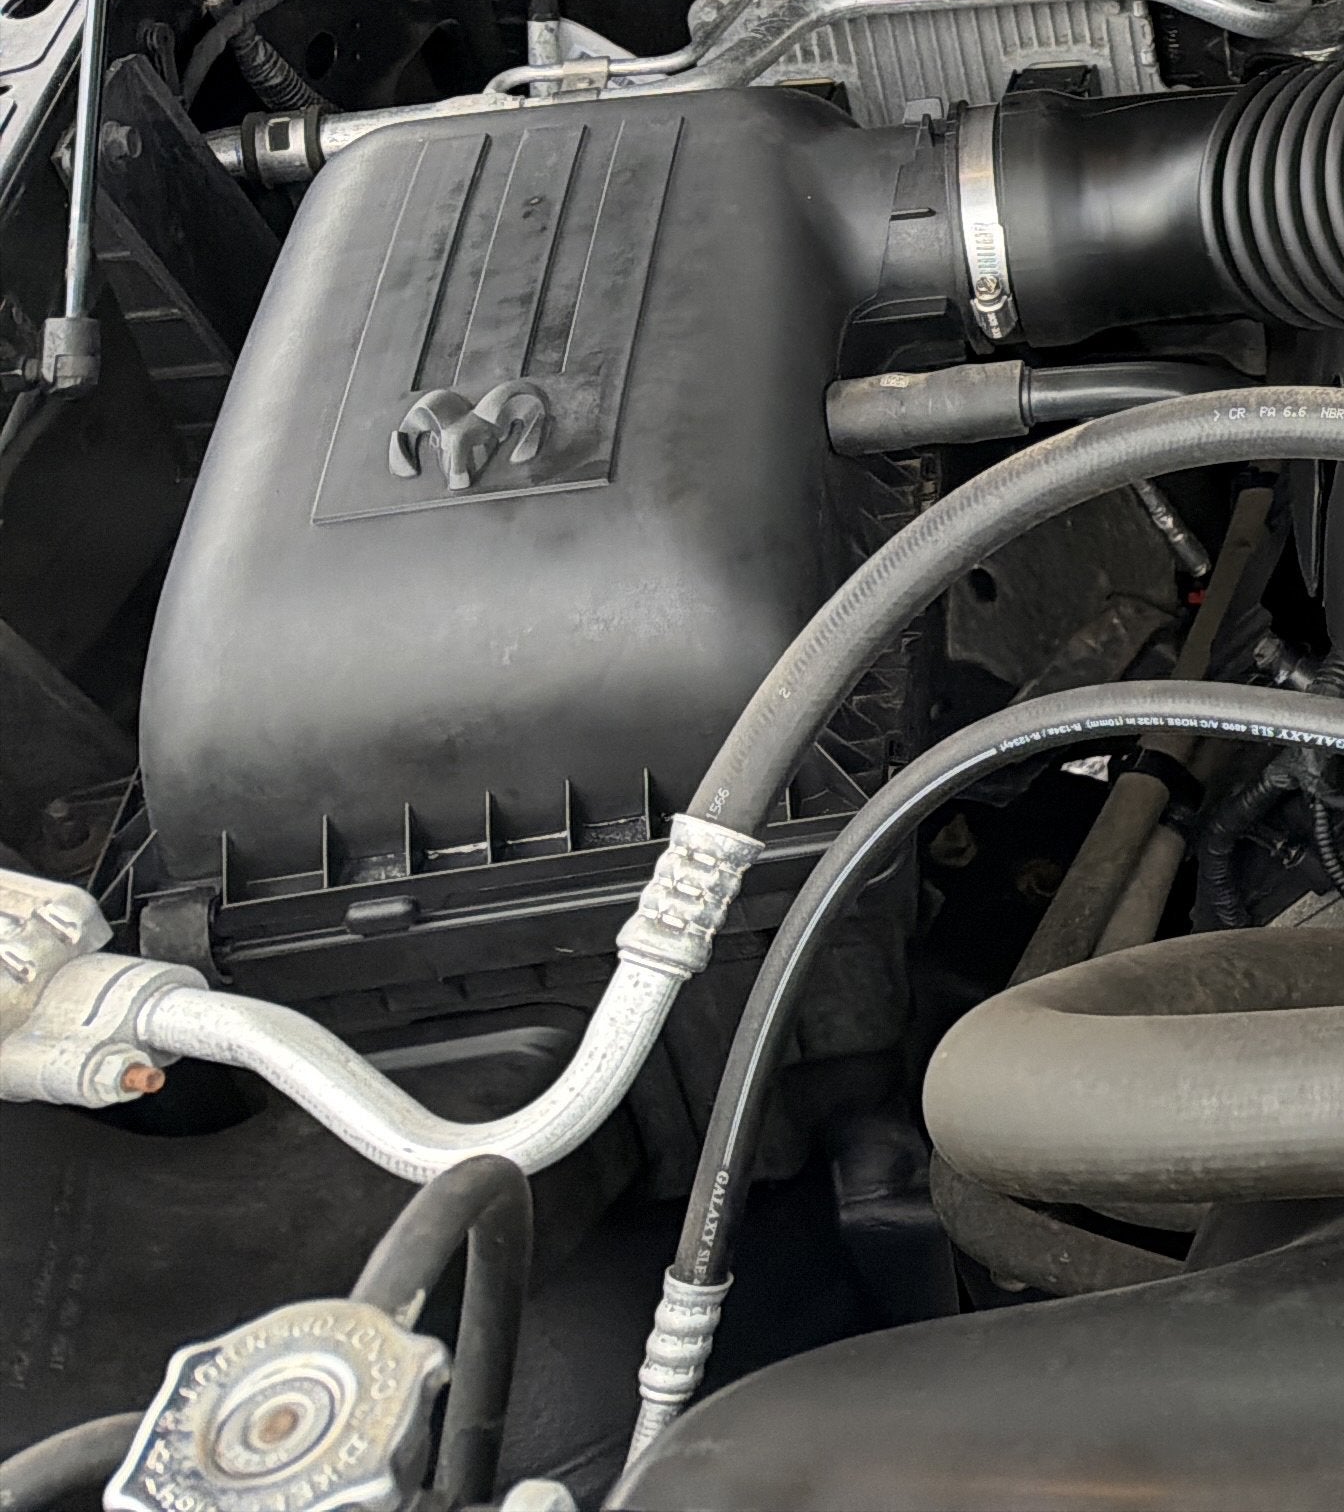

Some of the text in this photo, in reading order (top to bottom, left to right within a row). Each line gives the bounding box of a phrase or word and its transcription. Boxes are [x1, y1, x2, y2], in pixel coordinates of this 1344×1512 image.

[1229, 407, 1246, 420] CR
[1259, 406, 1276, 418] PA
[1283, 406, 1307, 418] 6.6
[1320, 407, 1344, 420] NBR
[1167, 717, 1199, 728] HOSE
[1200, 719, 1219, 731] A/C
[1251, 725, 1275, 738] SLE
[705, 787, 730, 820] 1566
[693, 1170, 730, 1275] GALAXY SLE
